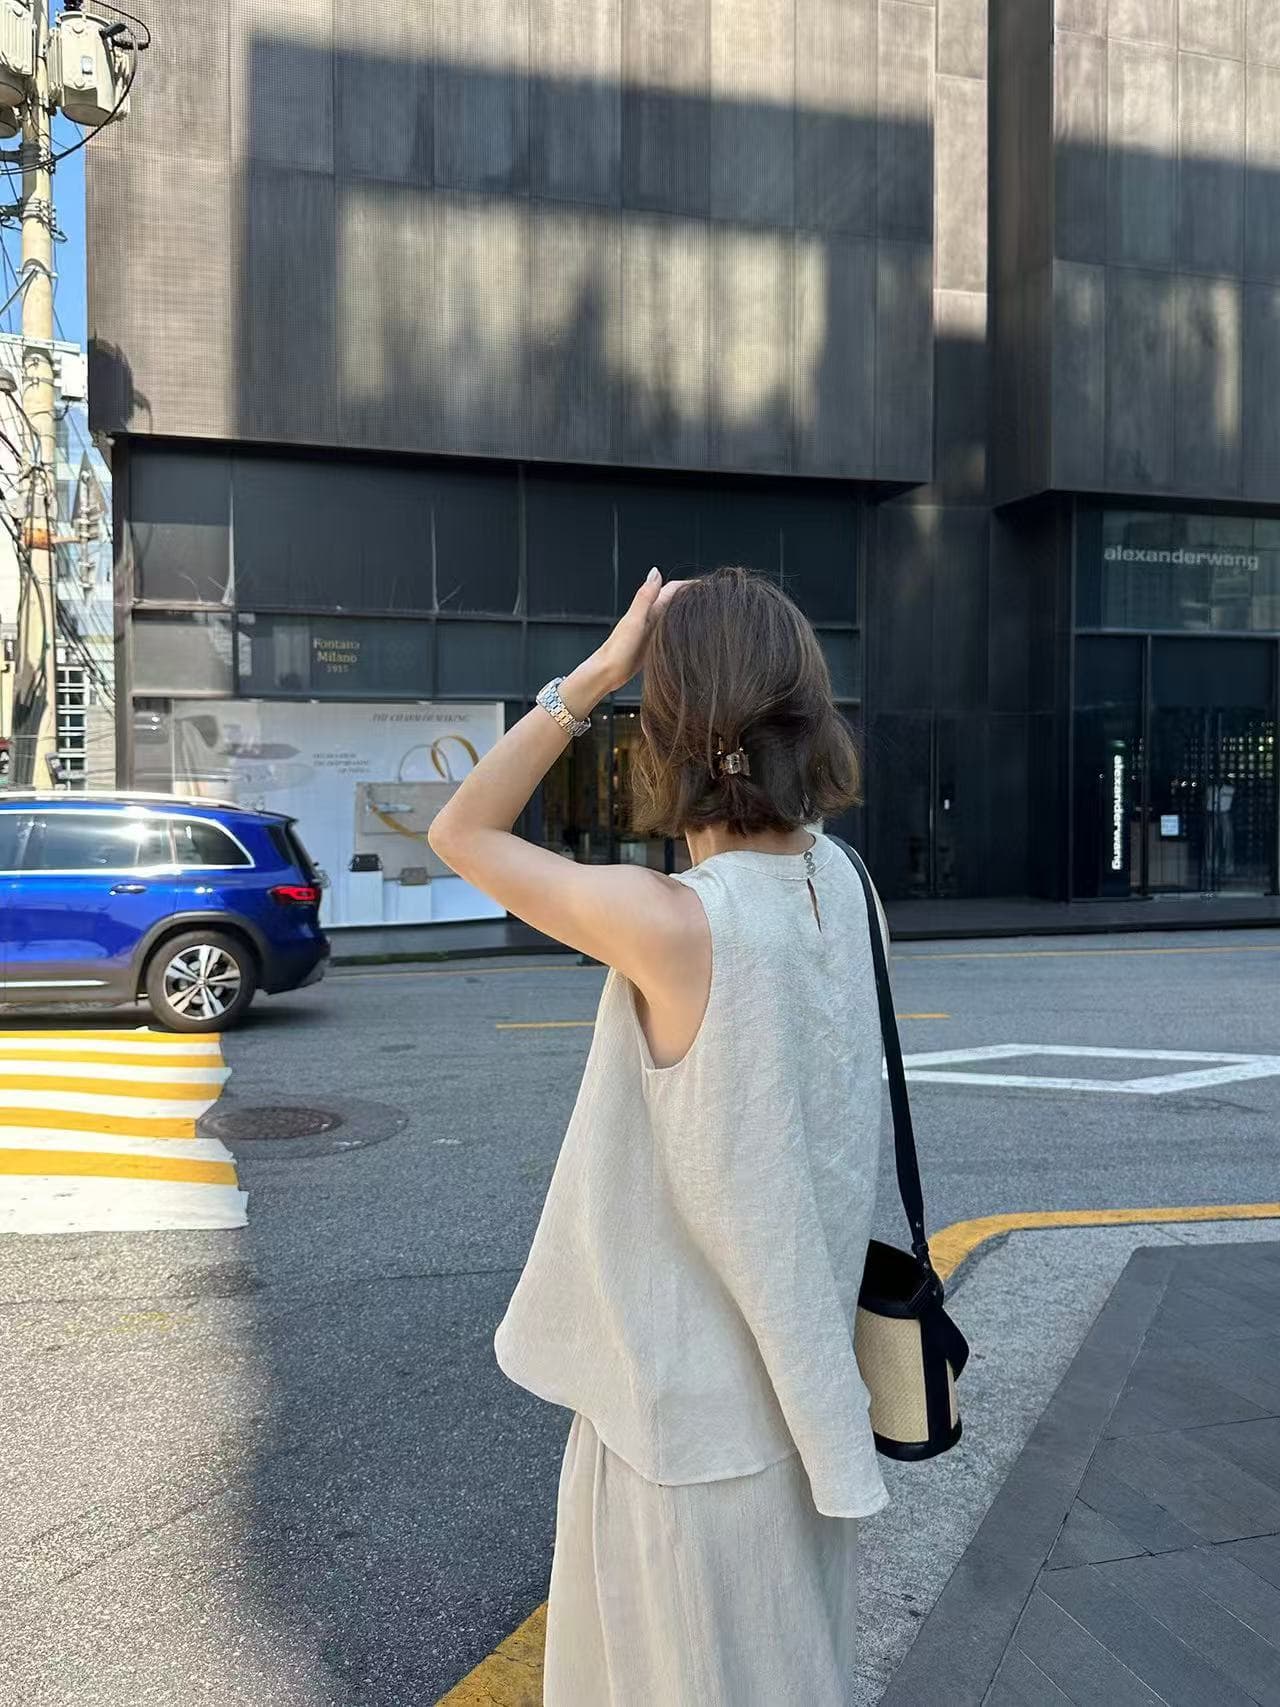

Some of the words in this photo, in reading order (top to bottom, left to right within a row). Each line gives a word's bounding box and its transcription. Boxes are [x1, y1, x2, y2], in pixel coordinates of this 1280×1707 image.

[1103, 545, 1259, 571] alexanderwang
[317, 651, 358, 662] Milano
[1111, 754, 1124, 870] alexanderwang
